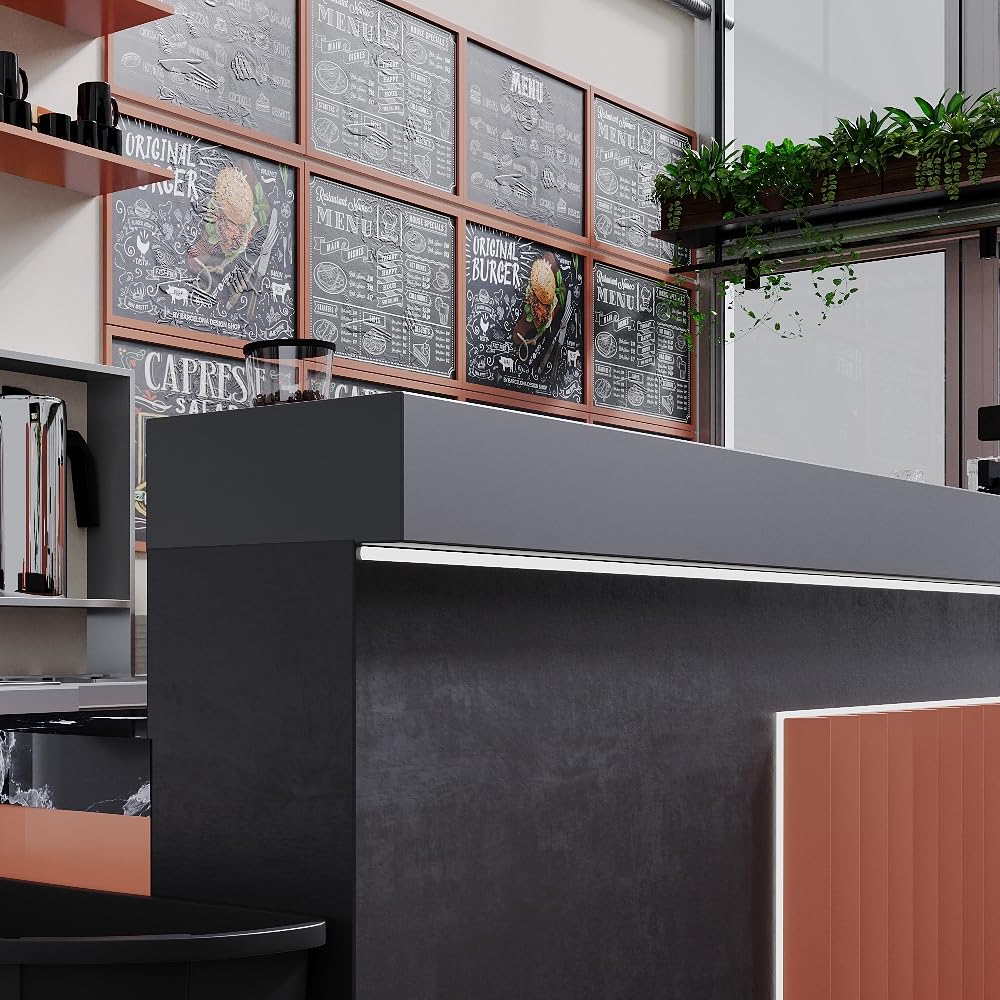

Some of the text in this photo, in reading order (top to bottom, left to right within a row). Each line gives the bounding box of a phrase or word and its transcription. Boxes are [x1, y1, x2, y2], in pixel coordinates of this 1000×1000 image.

[318, 4, 373, 42] MENU
[125, 132, 196, 168] ORIGINAL
[316, 205, 373, 238] MENU
[473, 235, 519, 262] ORIGINAL
[472, 257, 521, 291] BURGER
[596, 285, 636, 311] MENU
